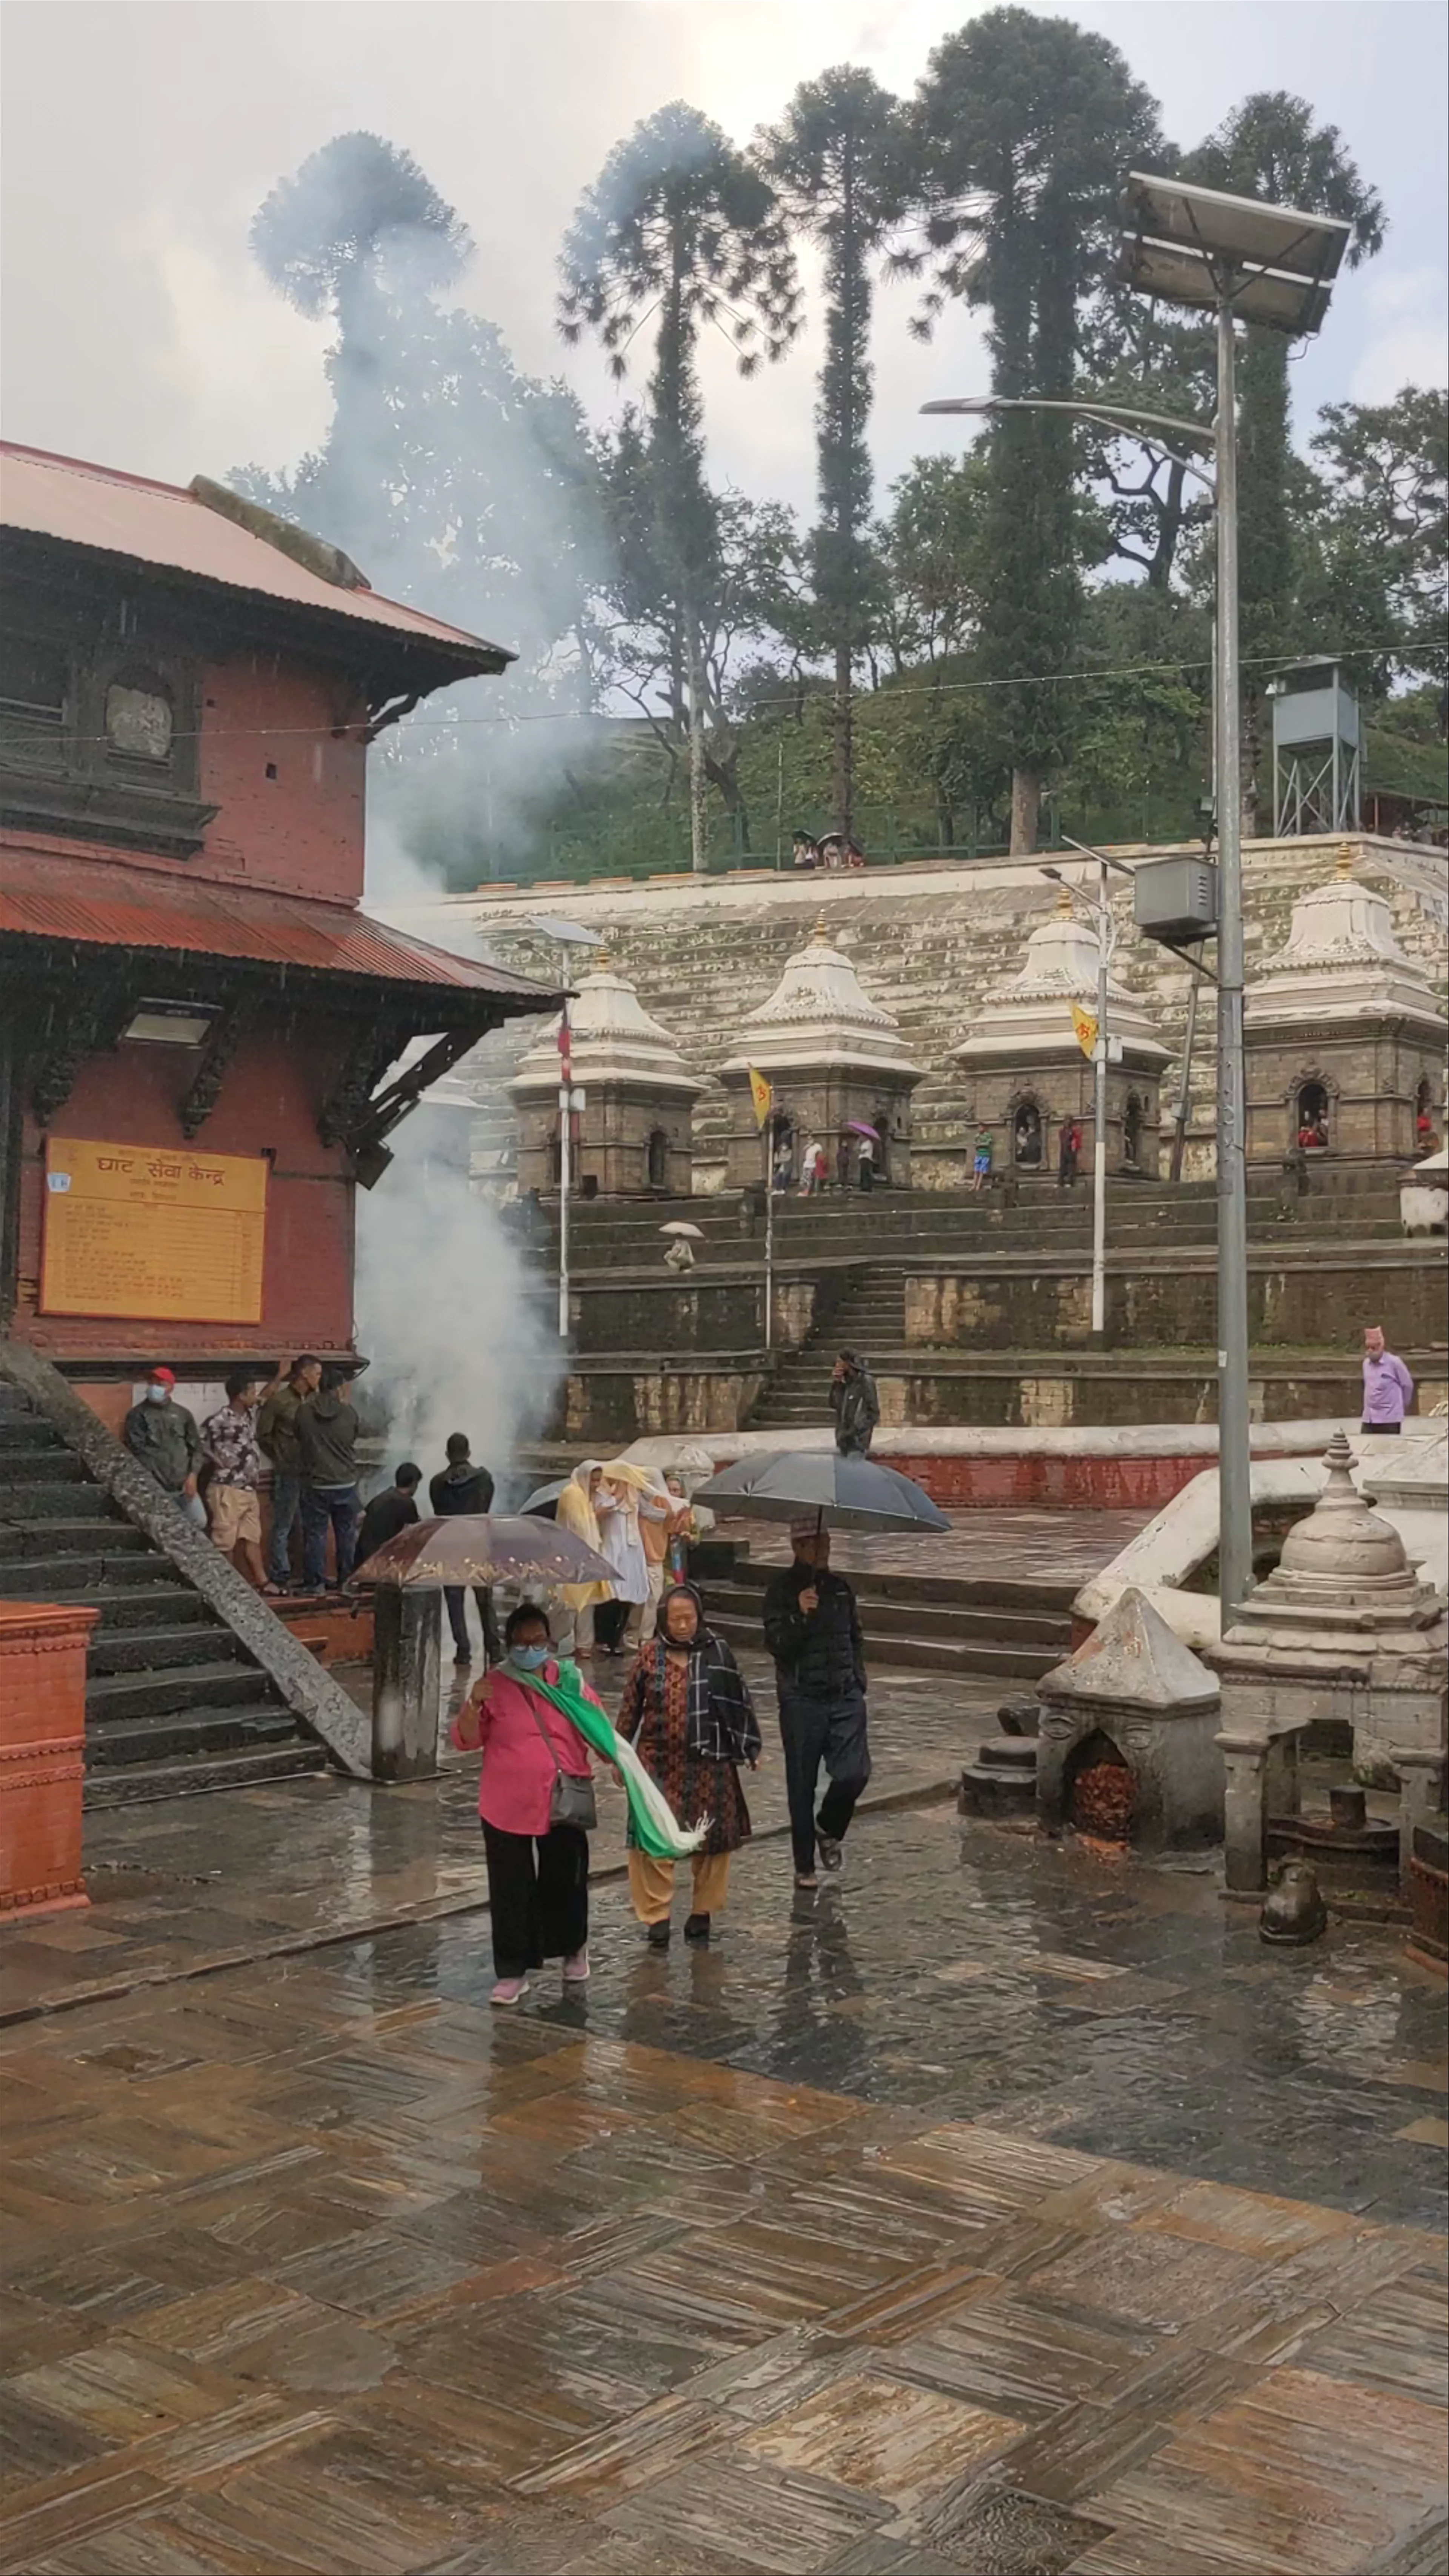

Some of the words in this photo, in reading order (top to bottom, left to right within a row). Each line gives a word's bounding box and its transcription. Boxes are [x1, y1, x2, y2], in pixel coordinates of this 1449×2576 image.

[96, 1157, 134, 1173] घाट
[146, 1158, 182, 1178] सेवा
[189, 1163, 225, 1186] केन्द्र
